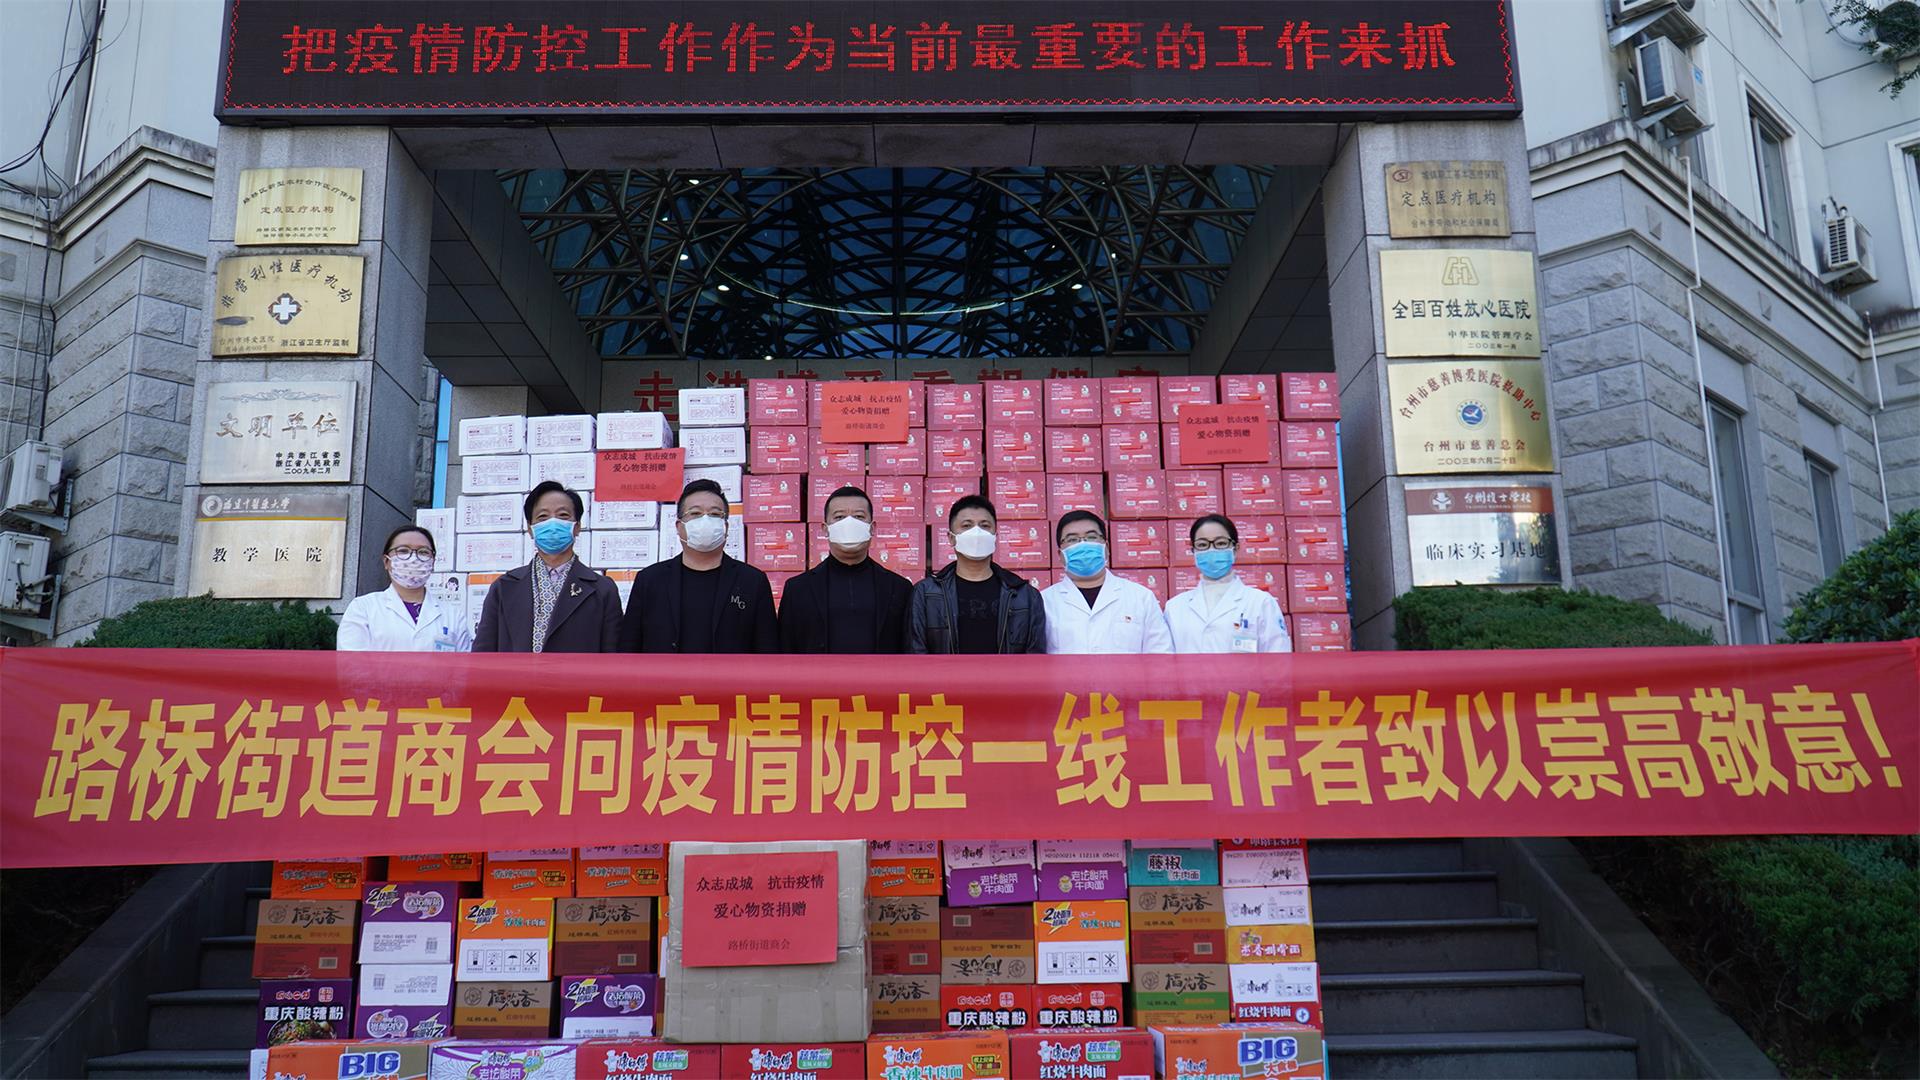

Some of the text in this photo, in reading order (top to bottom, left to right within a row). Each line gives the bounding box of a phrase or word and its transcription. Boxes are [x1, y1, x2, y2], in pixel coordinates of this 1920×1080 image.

[282, 22, 1456, 74] 把疫情防控工作作为当前最重要的工作来抓
[1401, 189, 1496, 207] 定点医疗机构
[221, 259, 352, 307] 非营利性医疗机构
[1392, 300, 1531, 319] 全国百姓放心医院
[1448, 330, 1533, 341] 中华医院管理学会
[1400, 368, 1541, 421] 台州市慈善博爱医院救助中心
[216, 412, 340, 439] 文明单位
[1424, 439, 1526, 452] 台州市慈善总会
[275, 459, 341, 467] 浙江省人民政府
[212, 547, 322, 562] 教学医院
[1426, 542, 1545, 561] 临床实习基地
[1148, 855, 1181, 870] 藤椒
[696, 874, 824, 892] 众志成城 抗击疫情
[980, 874, 1018, 887] 老坛酸菜
[1071, 870, 1109, 881] 老坛酸菜
[1170, 870, 1200, 880] 牛肉面
[984, 884, 1015, 895] 牛肉面
[1074, 880, 1104, 891] 牛肉面
[714, 901, 807, 919] 爱心物资捐赠
[1162, 893, 1213, 915] 稻花香
[588, 904, 640, 925] 稻花香
[879, 904, 929, 925] 稻花香
[728, 939, 790, 951] 路桥街道商会
[1165, 973, 1216, 994] 稻花香
[879, 982, 930, 1004] 稻花香
[264, 1006, 344, 1020] 重庆酸辣粉
[948, 1010, 1026, 1026] 重庆酸辣粉
[1039, 1009, 1118, 1026] 重庆酸辣粉
[1239, 1006, 1291, 1018] 红烧牛肉面
[1240, 1039, 1296, 1063] BIG
[341, 1052, 400, 1079] BIG
[1040, 1063, 1106, 1079] 红烧牛肉面
